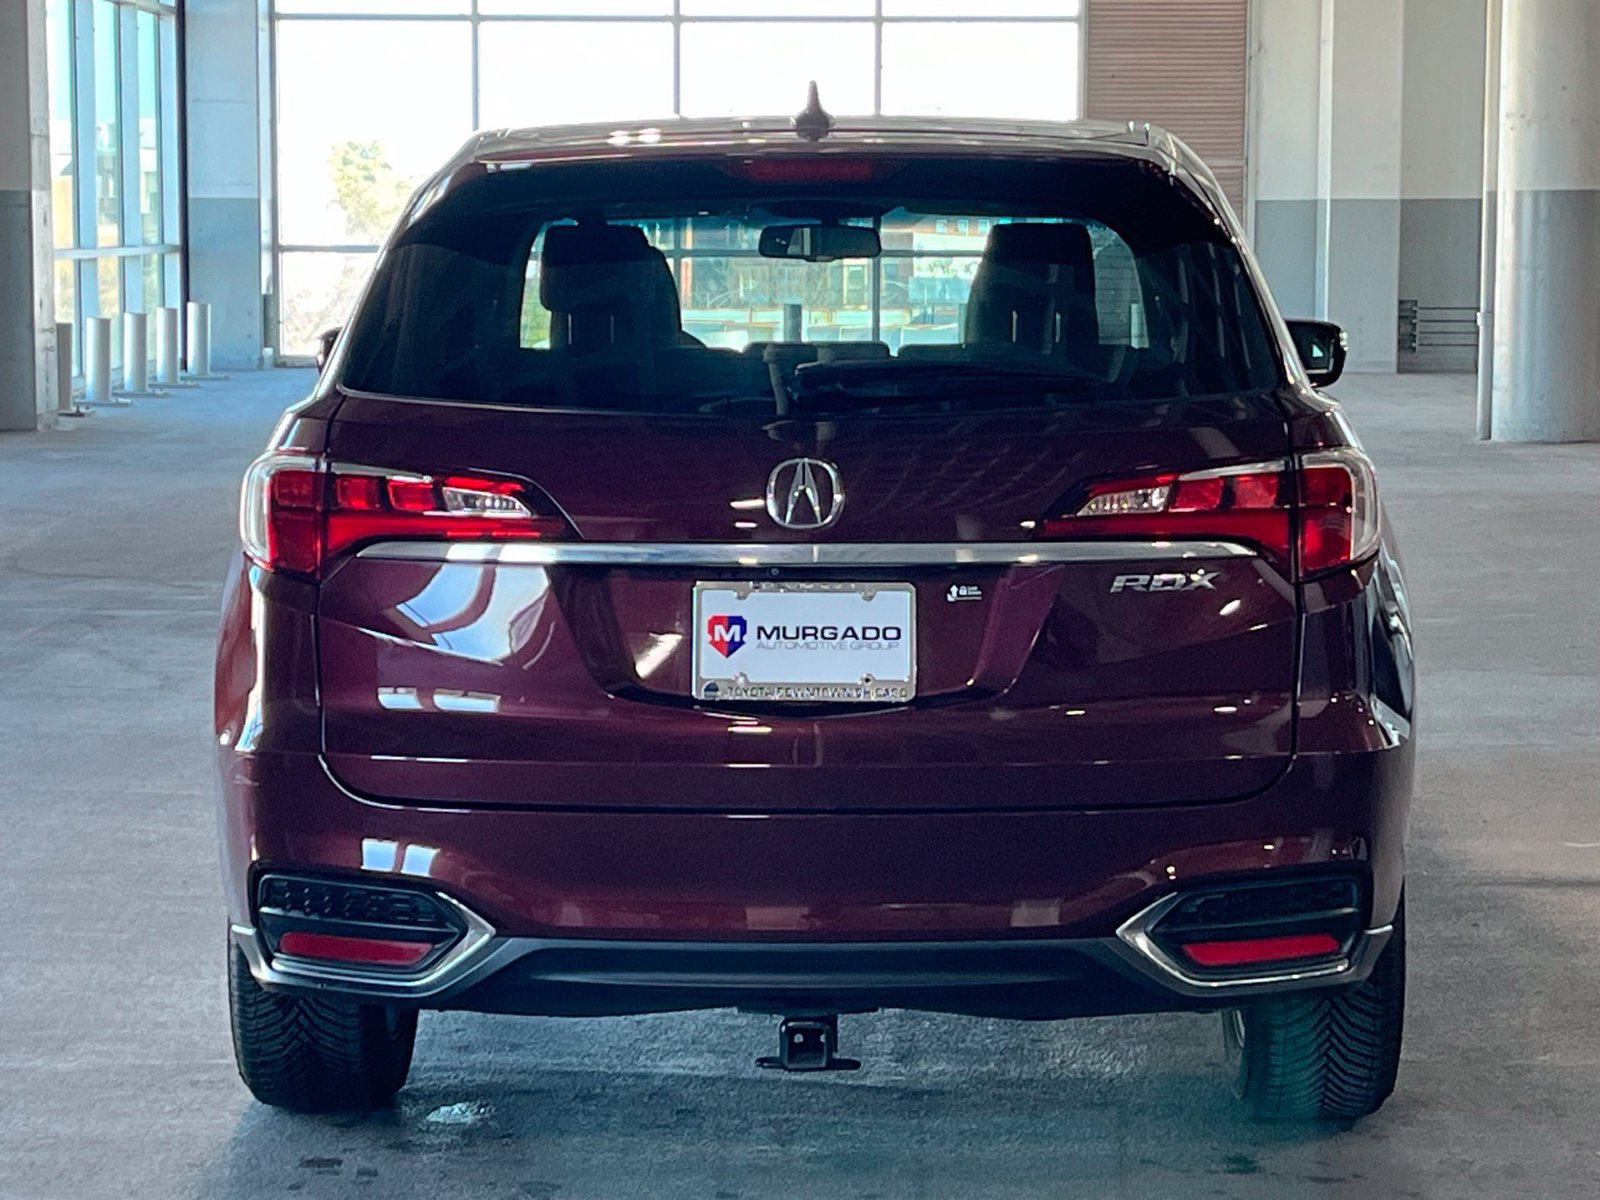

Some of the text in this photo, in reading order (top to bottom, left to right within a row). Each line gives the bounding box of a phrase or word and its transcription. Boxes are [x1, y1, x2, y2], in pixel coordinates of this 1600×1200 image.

[1109, 571, 1220, 593] RDX
[713, 624, 741, 642] M
[757, 625, 901, 641] MURGADO
[756, 641, 900, 651] AUTOMOTIVE GROUP
